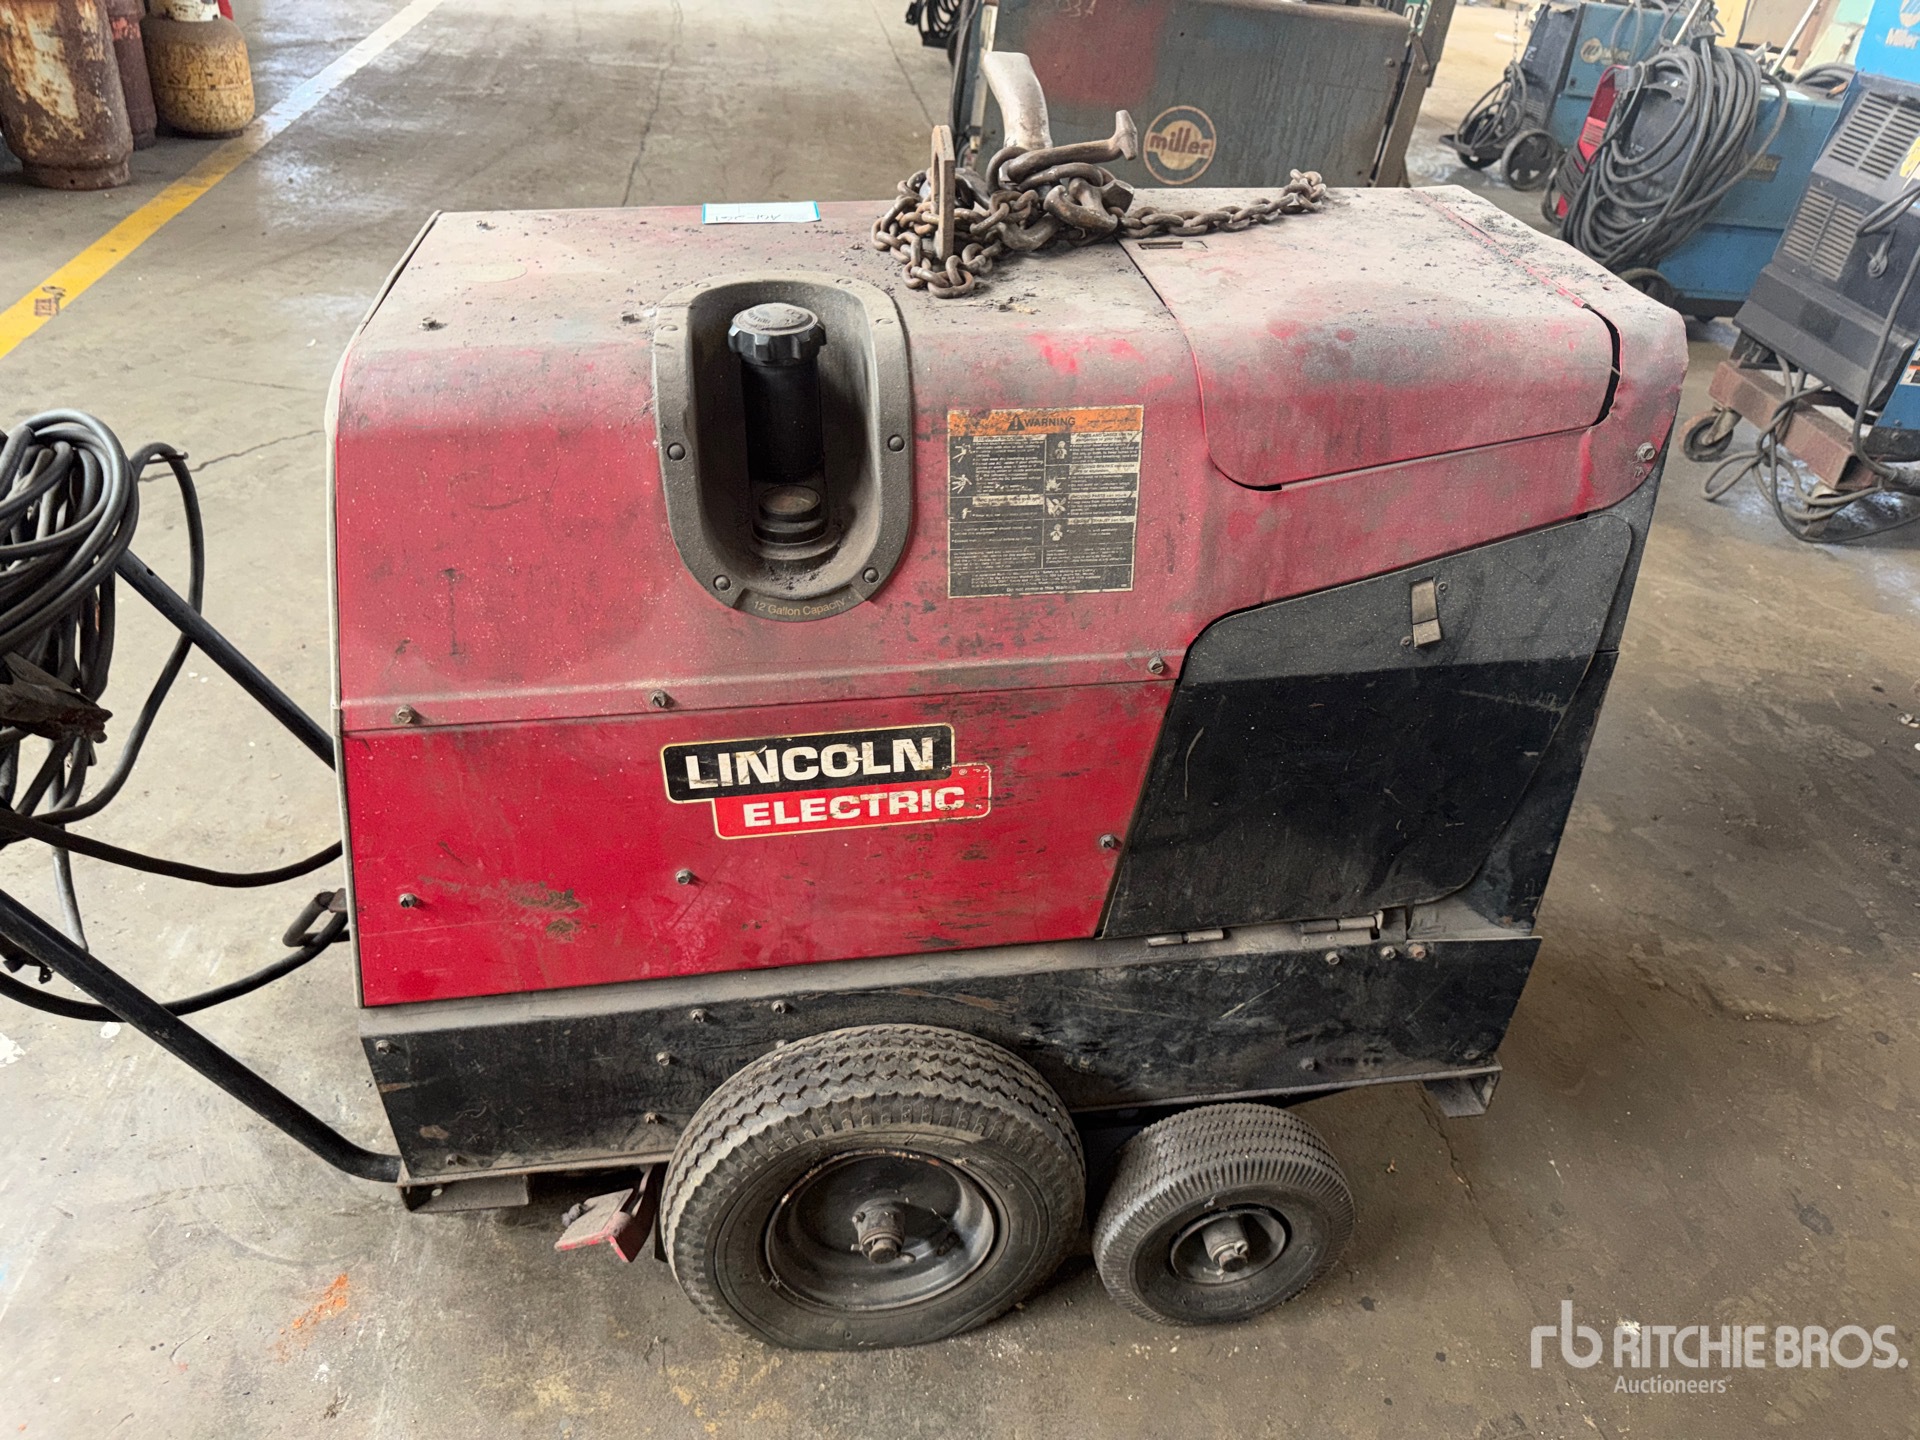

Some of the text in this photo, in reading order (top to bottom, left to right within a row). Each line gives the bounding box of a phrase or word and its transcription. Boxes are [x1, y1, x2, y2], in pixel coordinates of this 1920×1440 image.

[1150, 127, 1210, 154] miller
[1023, 416, 1076, 427] WARNING
[754, 598, 846, 616] 12 Gallon Capacity
[685, 737, 934, 790] LINCOLN
[743, 787, 966, 828] ELECTRIC
